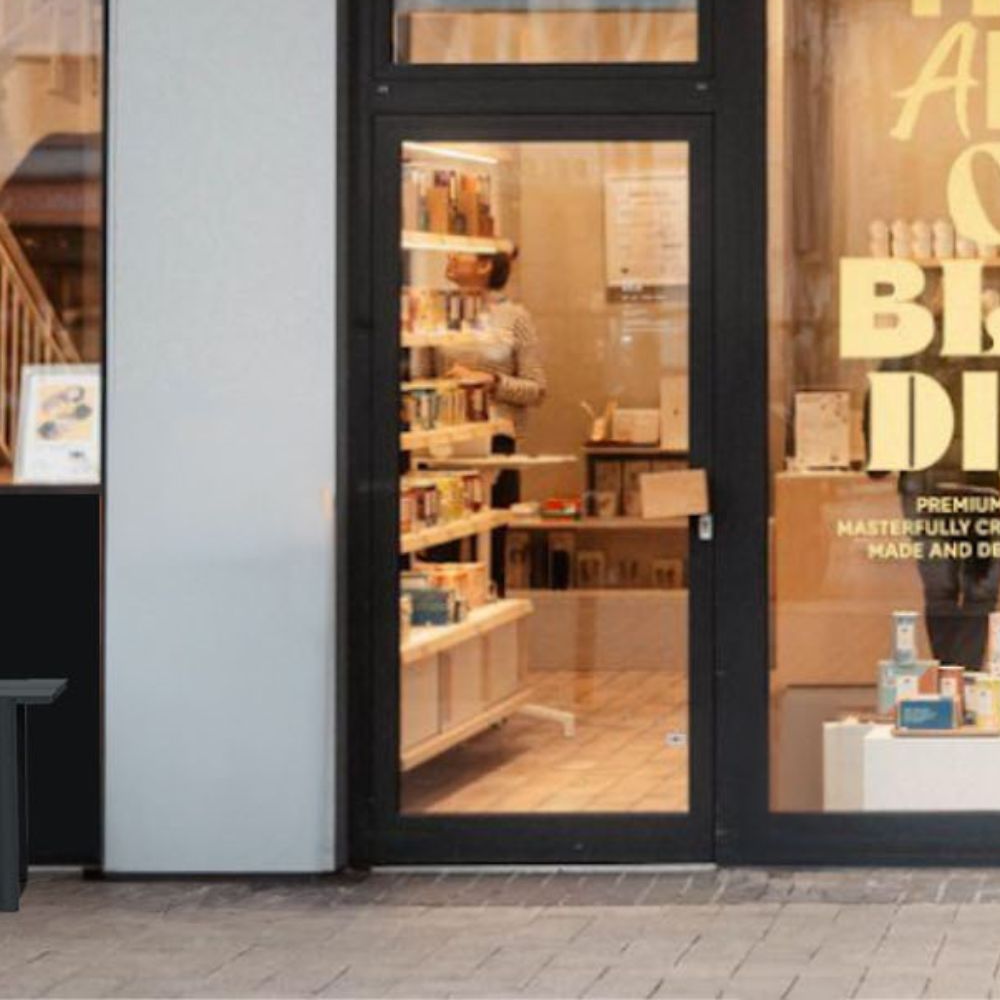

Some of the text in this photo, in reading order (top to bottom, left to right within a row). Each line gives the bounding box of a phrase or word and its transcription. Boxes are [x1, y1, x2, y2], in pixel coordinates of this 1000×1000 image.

[836, 518, 971, 536] MASTERFULLY
[868, 541, 925, 559] MADE
[928, 541, 973, 559] AND
